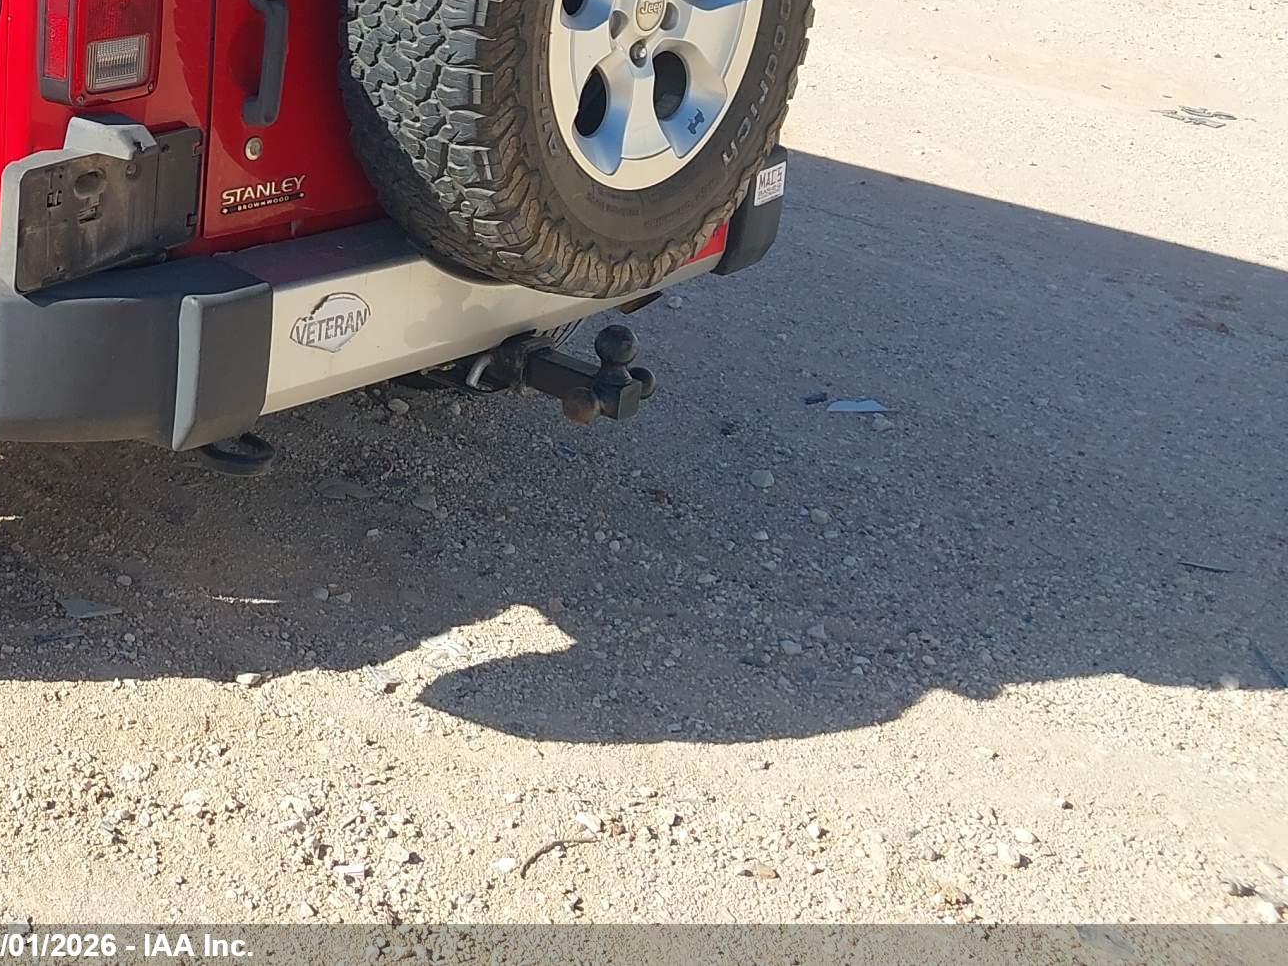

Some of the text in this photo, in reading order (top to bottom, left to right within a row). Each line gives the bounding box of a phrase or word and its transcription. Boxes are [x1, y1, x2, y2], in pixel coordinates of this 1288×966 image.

[640, 0, 664, 15] Jeep
[221, 174, 306, 206] STANLEY
[237, 195, 290, 212] BROWNWOOD
[295, 307, 368, 346] VETERAN
